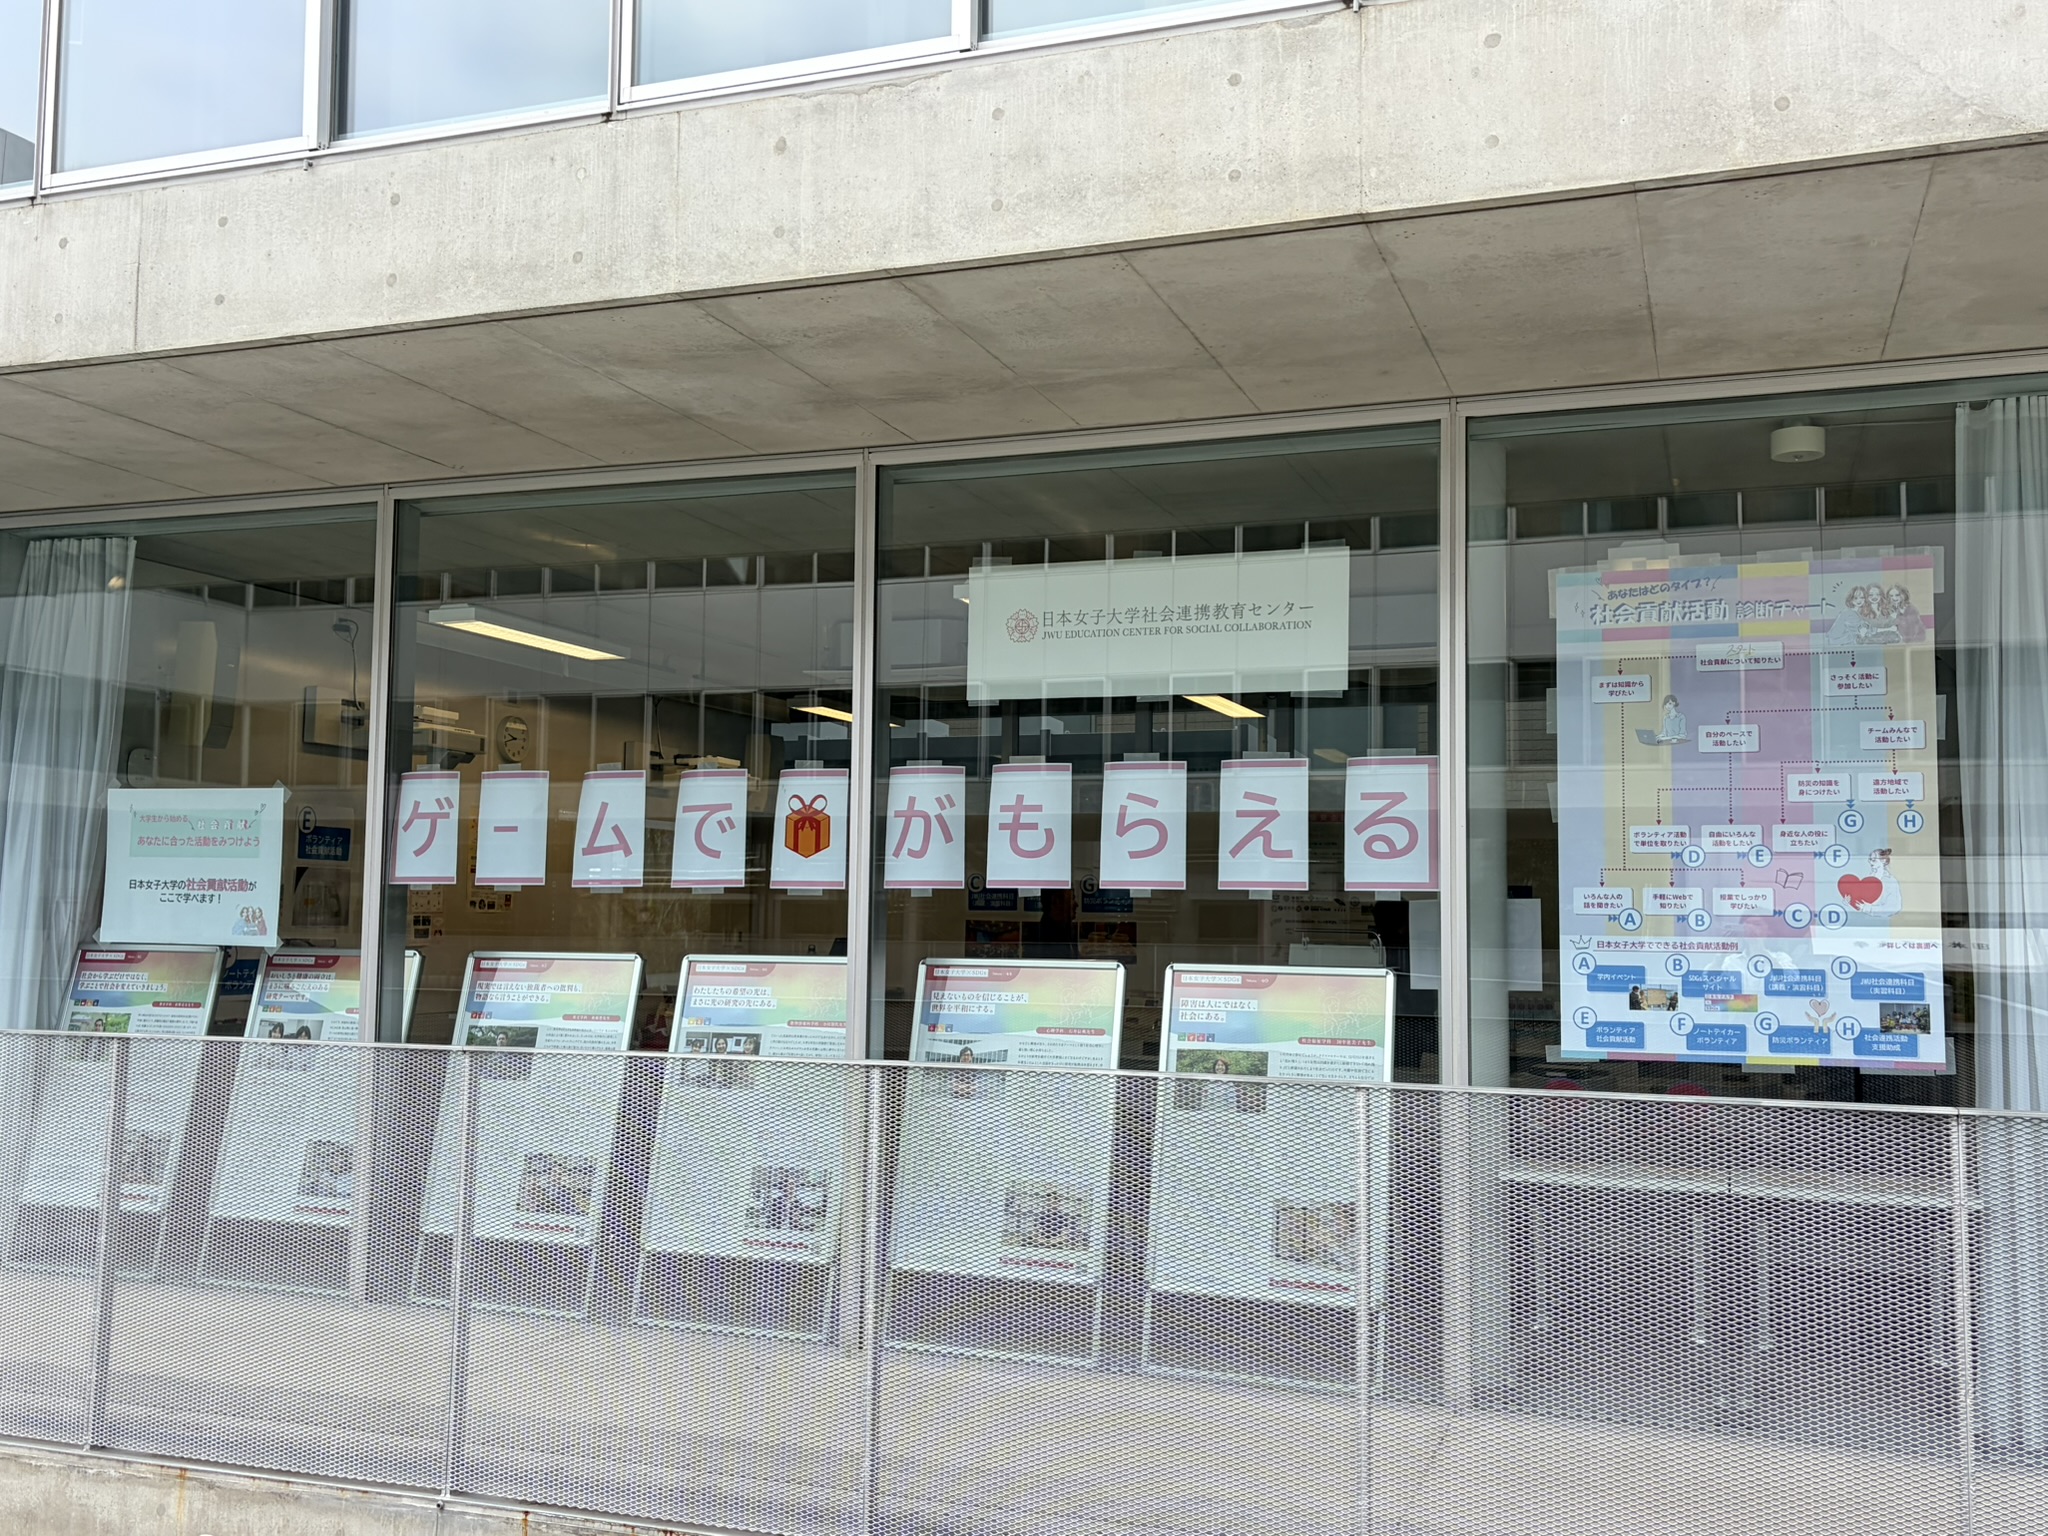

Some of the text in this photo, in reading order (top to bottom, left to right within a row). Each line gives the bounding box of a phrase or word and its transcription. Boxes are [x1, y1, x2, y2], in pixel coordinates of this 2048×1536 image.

[1607, 578, 1711, 600] あなたはどのタイプ？
[1042, 601, 1315, 628] 日本女子大学社会連携教育センター
[1590, 597, 1836, 626] 社会貢献活動 診断チャート
[1041, 620, 1312, 640] JWU EDUCATION CENTER FOR SOCIAL COLLABORATION
[1727, 644, 1756, 656] スタート
[1700, 656, 1782, 666] 社会貢献について知りたい
[1830, 673, 1879, 681] さっそく活動に
[1599, 680, 1645, 688] まずは知識から
[1837, 682, 1873, 690] 参加したい
[1608, 689, 1635, 697] 学びたい
[1705, 731, 1753, 739] 自分のペースで
[1868, 727, 1918, 735] チームみんなで
[1874, 736, 1911, 744] 活動したい
[1798, 779, 1840, 787] 防災の知識を
[1873, 778, 1909, 786] 遠方地域で
[1798, 789, 1840, 797] 身につけたい
[1873, 787, 1910, 795] 活動したい
[139, 814, 189, 823] 大学生から始める
[302, 811, 312, 831] E
[402, 791, 1419, 860] ゲームで がもらえる
[1633, 831, 1687, 839] ボランティア活動
[1708, 831, 1756, 839] 自由にいろんな
[1780, 830, 1828, 838] 身近な人の役に
[137, 836, 261, 848] あなたに合った活動をみつけよう
[1790, 839, 1818, 847] 立ちたい
[129, 878, 257, 893] 日本女子大学の社会貢献活動が
[159, 893, 222, 904] ここで学べます！
[1653, 893, 1694, 901] 手軽にWebで
[1597, 940, 1739, 951] 日本女子大学でできる社会貢献活動例
[1597, 973, 1636, 981] 学内イベント
[932, 991, 1028, 1003] 見えないものを信じることが、
[1180, 998, 1257, 1010] 障害は人にではなく、
[930, 1003, 995, 1014] 世界を平和にする。
[1180, 1012, 1226, 1022] 社会にある。
[1596, 1026, 1636, 1034] ボランティア
[1693, 1028, 1741, 1036] ノートテイカー
[1596, 1035, 1637, 1044] 社会貢献活動
[1696, 1037, 1738, 1045] ボランティア
[1772, 1036, 1828, 1045] 防災ボランティア
